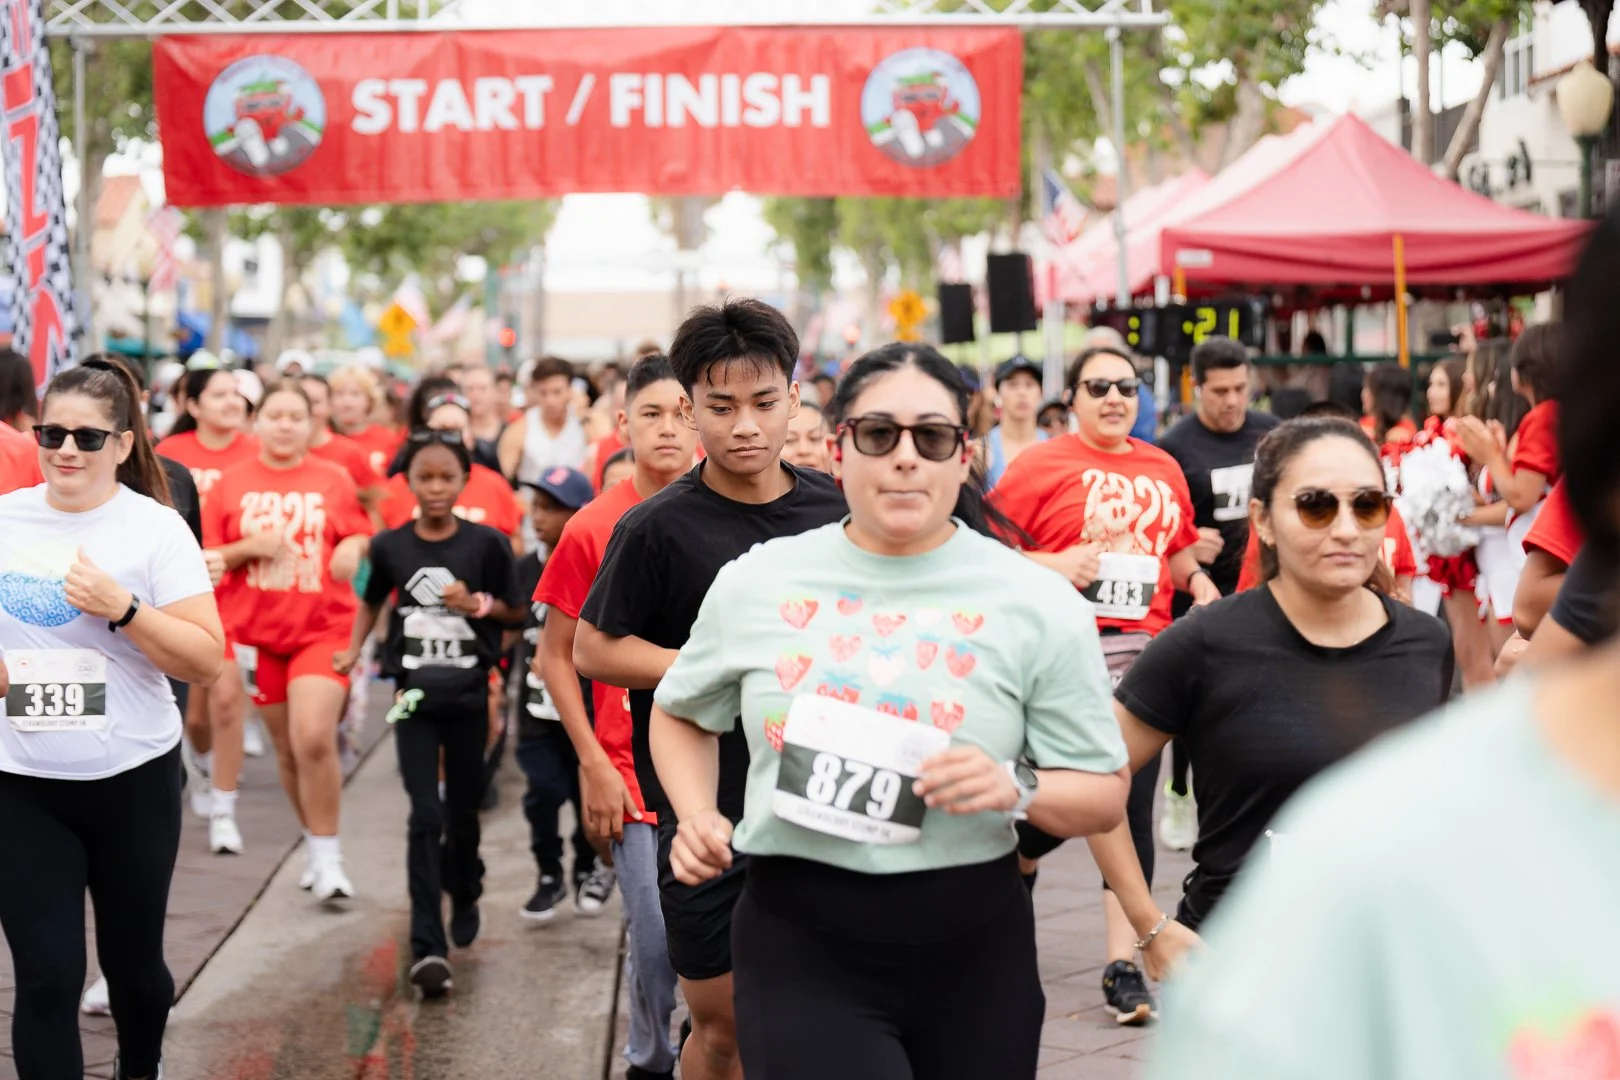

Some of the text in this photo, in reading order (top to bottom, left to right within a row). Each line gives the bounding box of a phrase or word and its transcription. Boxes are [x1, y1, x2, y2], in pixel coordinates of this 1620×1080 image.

[351, 72, 832, 136] START / FINISH
[1096, 580, 1143, 606] 483
[420, 638, 462, 659] 114
[24, 683, 84, 716] 339
[805, 752, 902, 821] 879
